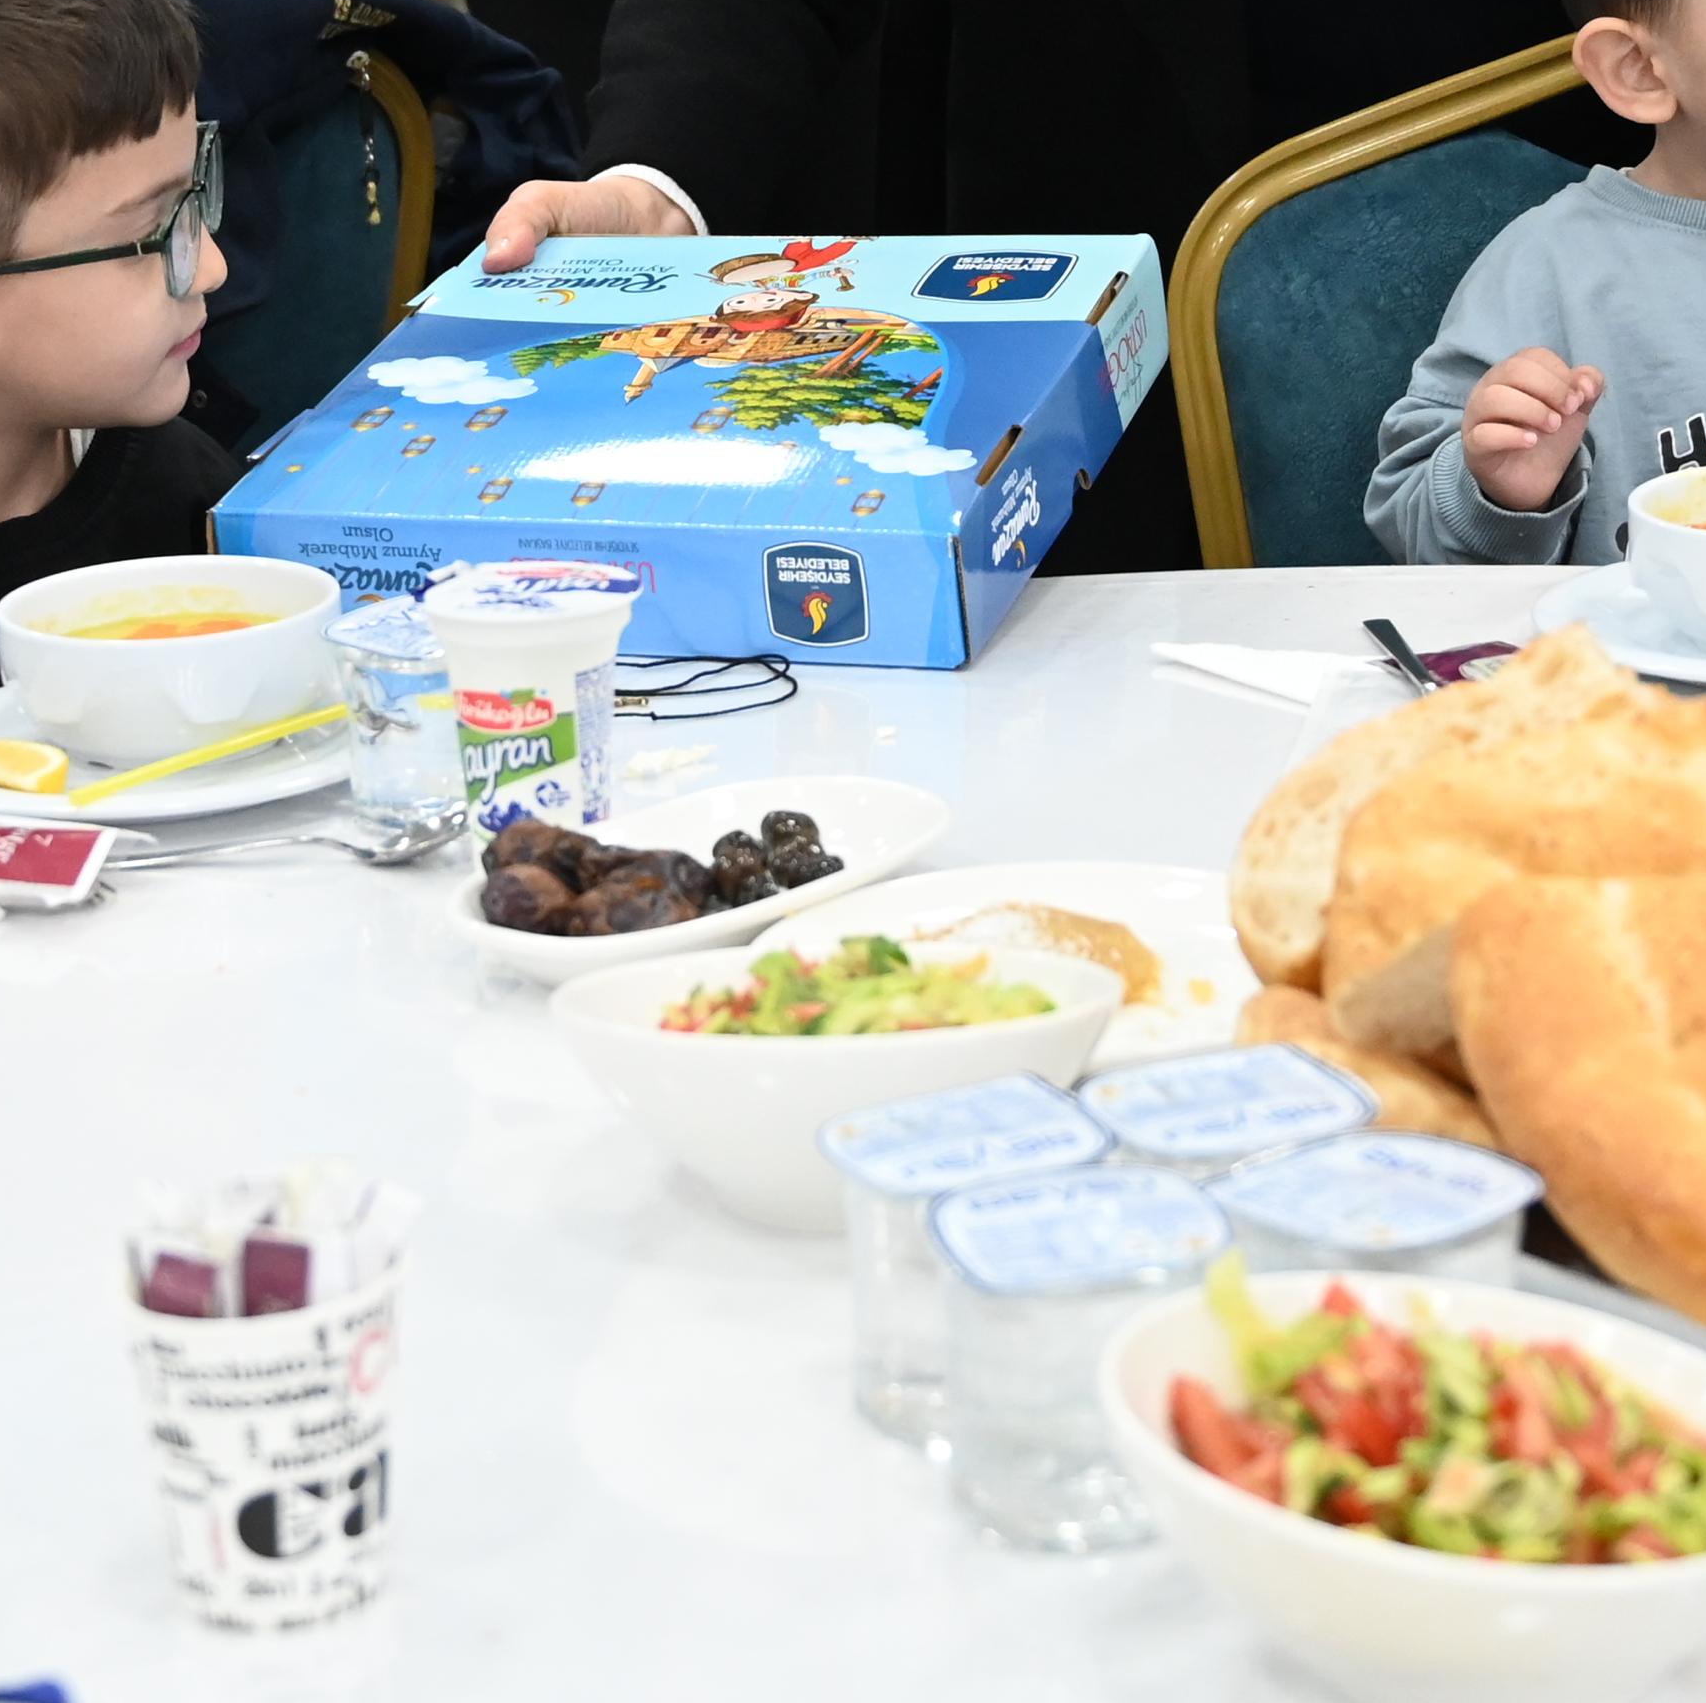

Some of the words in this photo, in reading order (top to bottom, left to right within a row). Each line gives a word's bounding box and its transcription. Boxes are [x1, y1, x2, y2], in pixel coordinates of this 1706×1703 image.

[469, 273, 679, 293] Ramazan
[342, 526, 394, 542] Olsun
[298, 542, 377, 560] Mübarek
[383, 545, 442, 562] Ayımız
[464, 735, 555, 805] ayran
